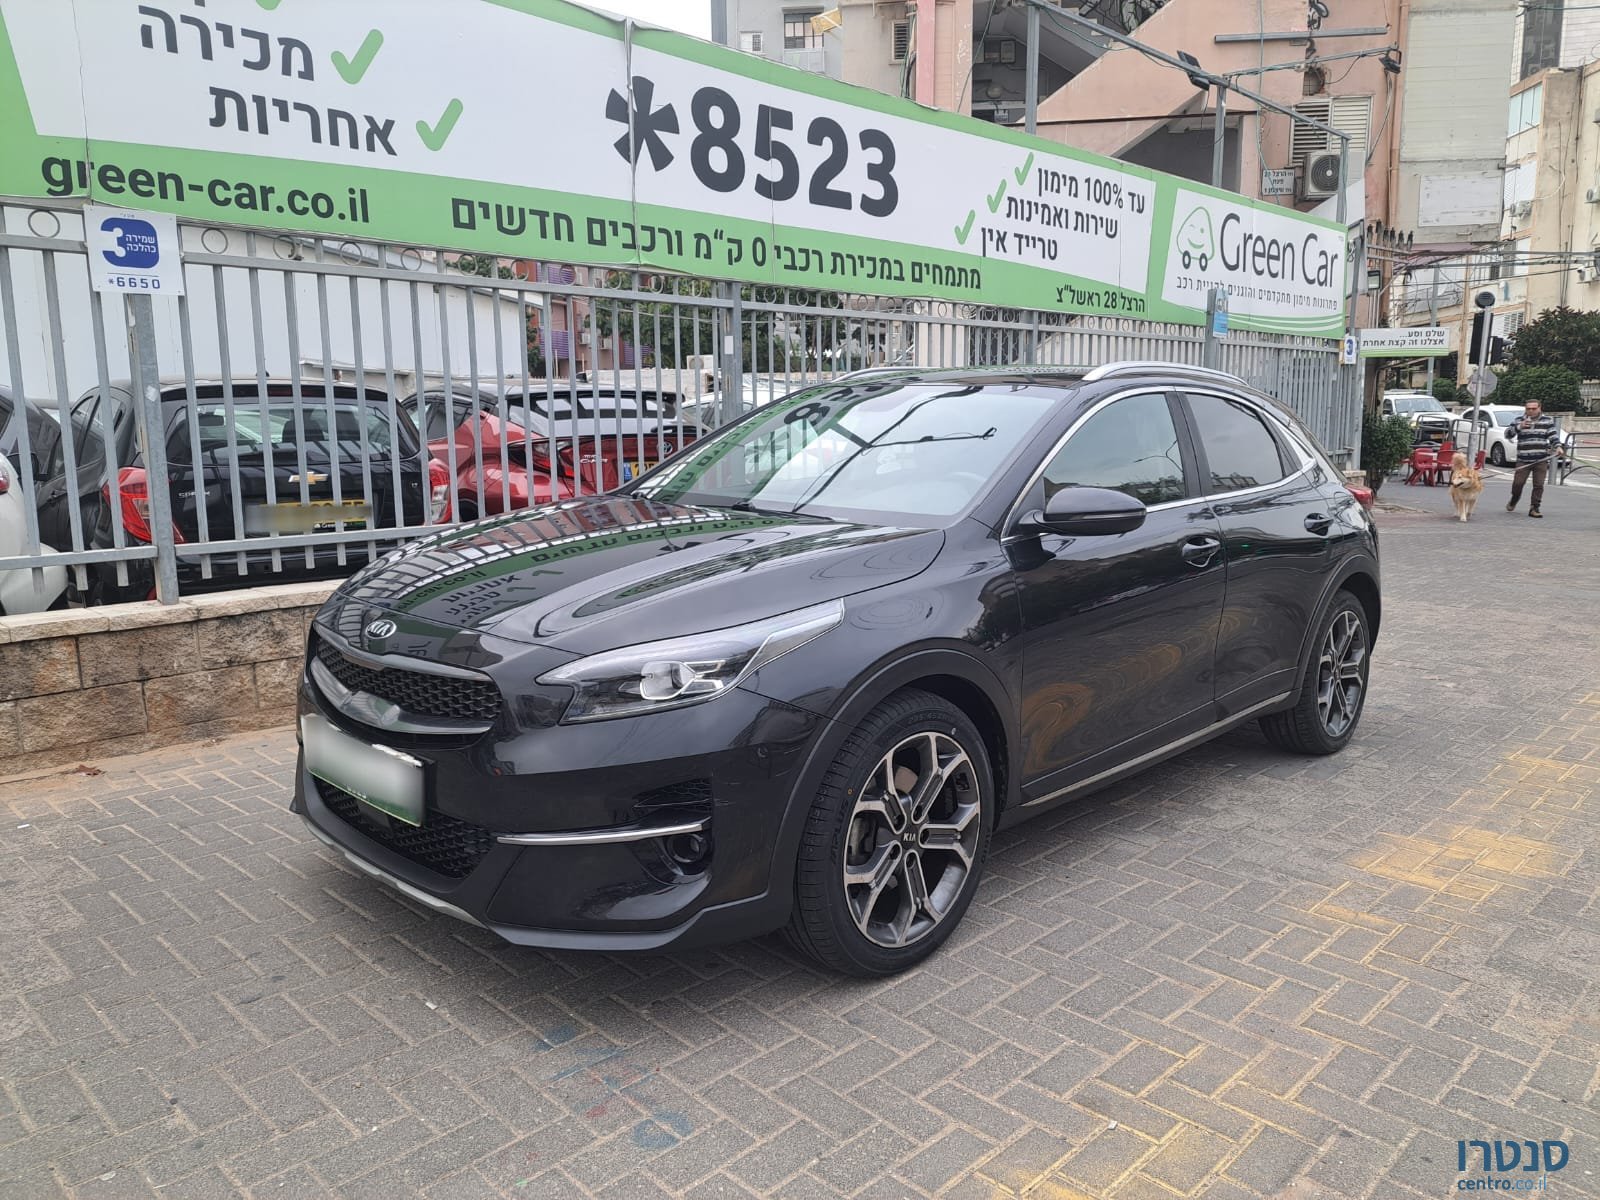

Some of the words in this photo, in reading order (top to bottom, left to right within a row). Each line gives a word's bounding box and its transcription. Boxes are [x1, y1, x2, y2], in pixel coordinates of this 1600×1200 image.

[138, 4, 315, 81] מכירה
[209, 85, 398, 156] אחריות
[41, 156, 370, 223] green-car.co.il
[1038, 167, 1079, 198] מימון
[1084, 176, 1124, 209] 100%
[1006, 196, 1069, 230] ואמינות
[1128, 191, 1145, 214] עד
[450, 196, 574, 242] חדשים
[1074, 210, 1118, 239] שירות
[125, 234, 155, 244] שמירה
[586, 216, 684, 257] ורכבים
[750, 236, 767, 265] 0
[981, 226, 1008, 258] אין
[1014, 232, 1058, 260] טרייד
[1220, 212, 1294, 281] Green
[1302, 232, 1339, 288] Car
[774, 243, 826, 274] רכבי
[829, 249, 904, 283] במכירת
[911, 255, 982, 290] מתמחים
[1176, 276, 1193, 290] רכב
[1104, 291, 1118, 309] 28
[1120, 292, 1145, 313] הרצל
[1388, 339, 1406, 348] קצת
[1420, 338, 1444, 346] אצלנו
[1426, 329, 1445, 338] שלם
[903, 832, 916, 842] KIA
